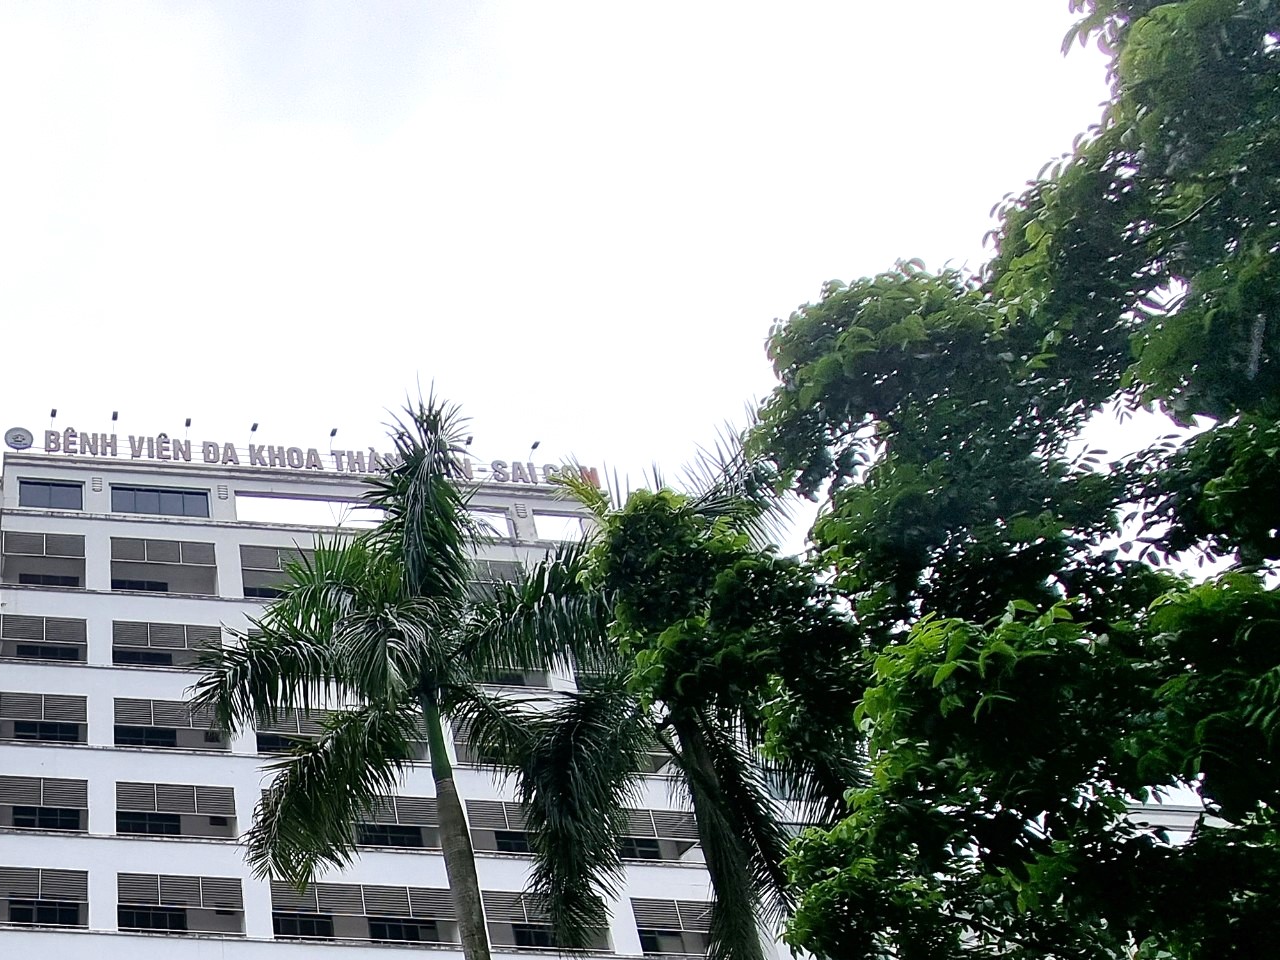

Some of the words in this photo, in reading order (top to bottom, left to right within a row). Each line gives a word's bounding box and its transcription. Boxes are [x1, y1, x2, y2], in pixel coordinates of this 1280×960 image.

[202, 440, 240, 465] ĐA
[248, 443, 324, 470] KHOA
[331, 447, 407, 474] THÀN
